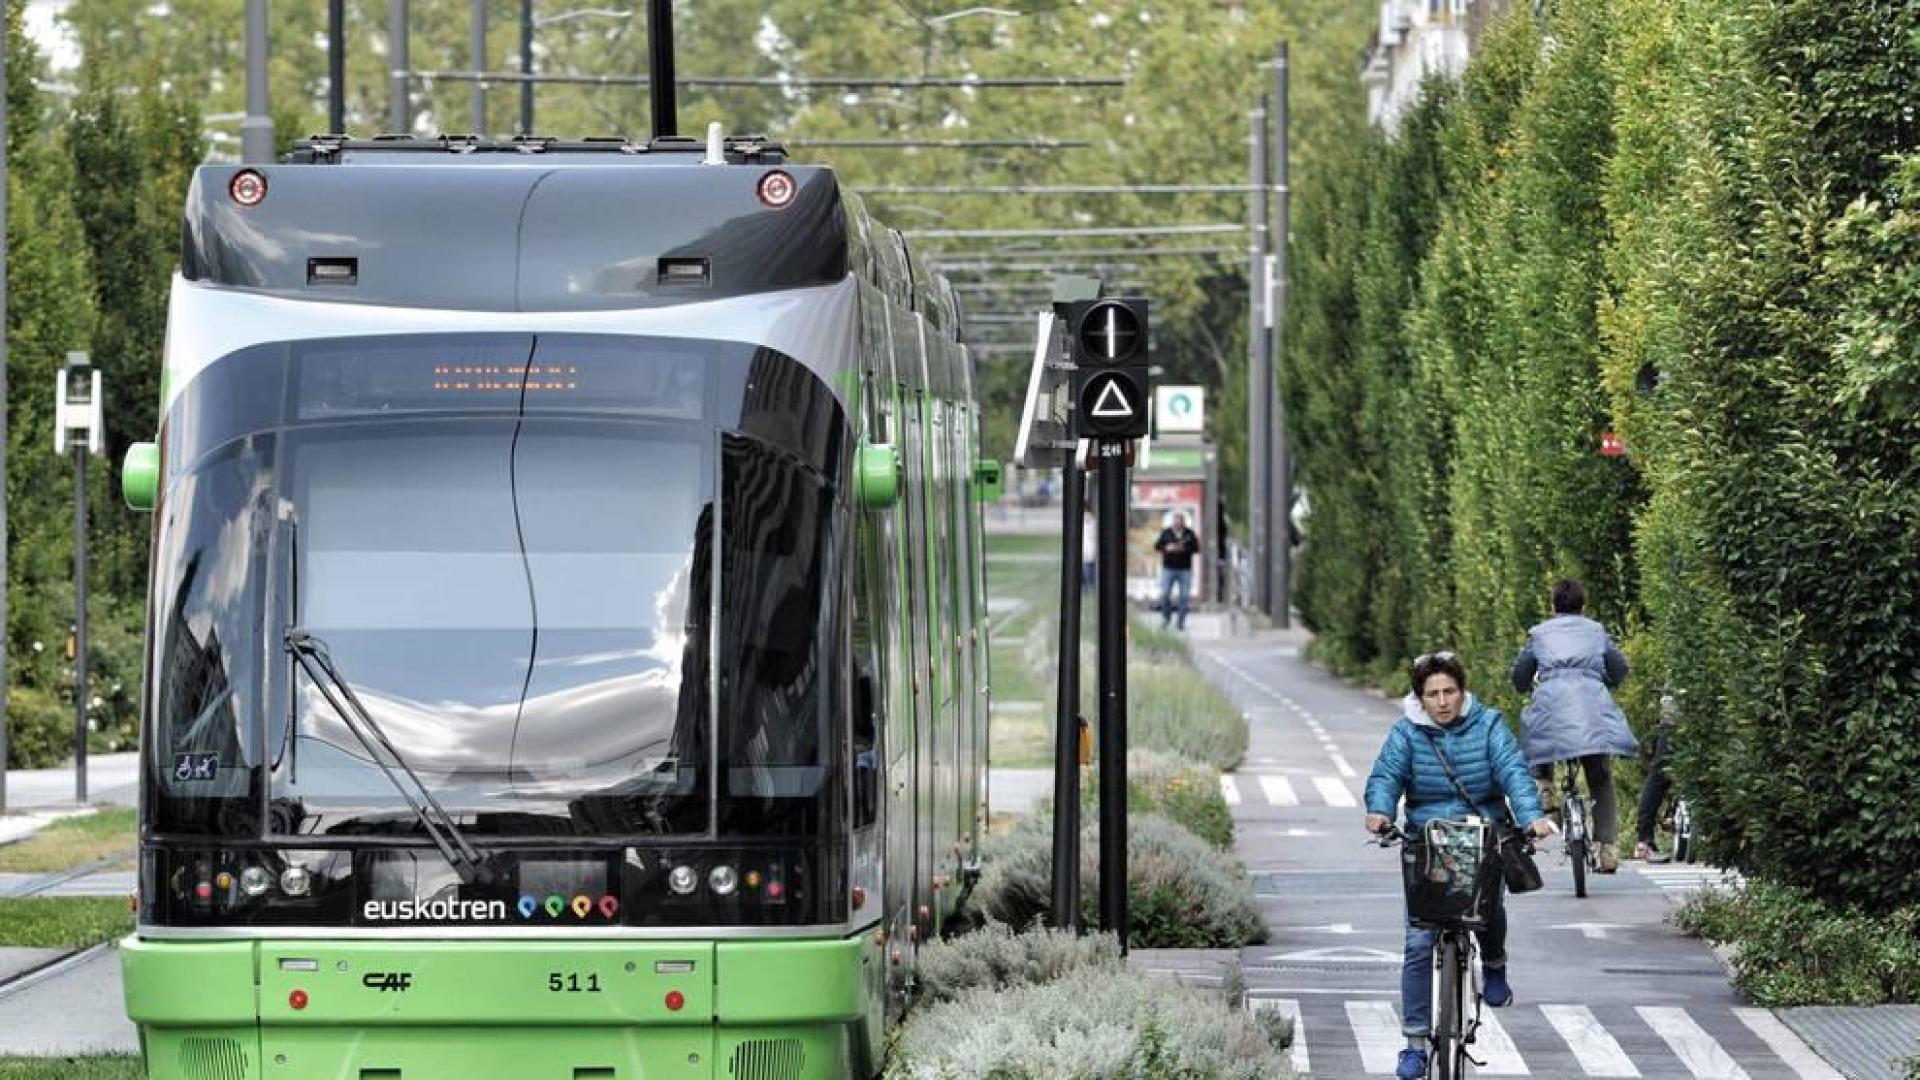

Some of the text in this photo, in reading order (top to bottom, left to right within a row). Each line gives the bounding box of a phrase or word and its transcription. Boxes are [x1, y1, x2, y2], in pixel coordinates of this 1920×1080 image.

[364, 896, 505, 920] euskotren
[363, 973, 411, 992] CAF
[549, 973, 601, 992] 511
